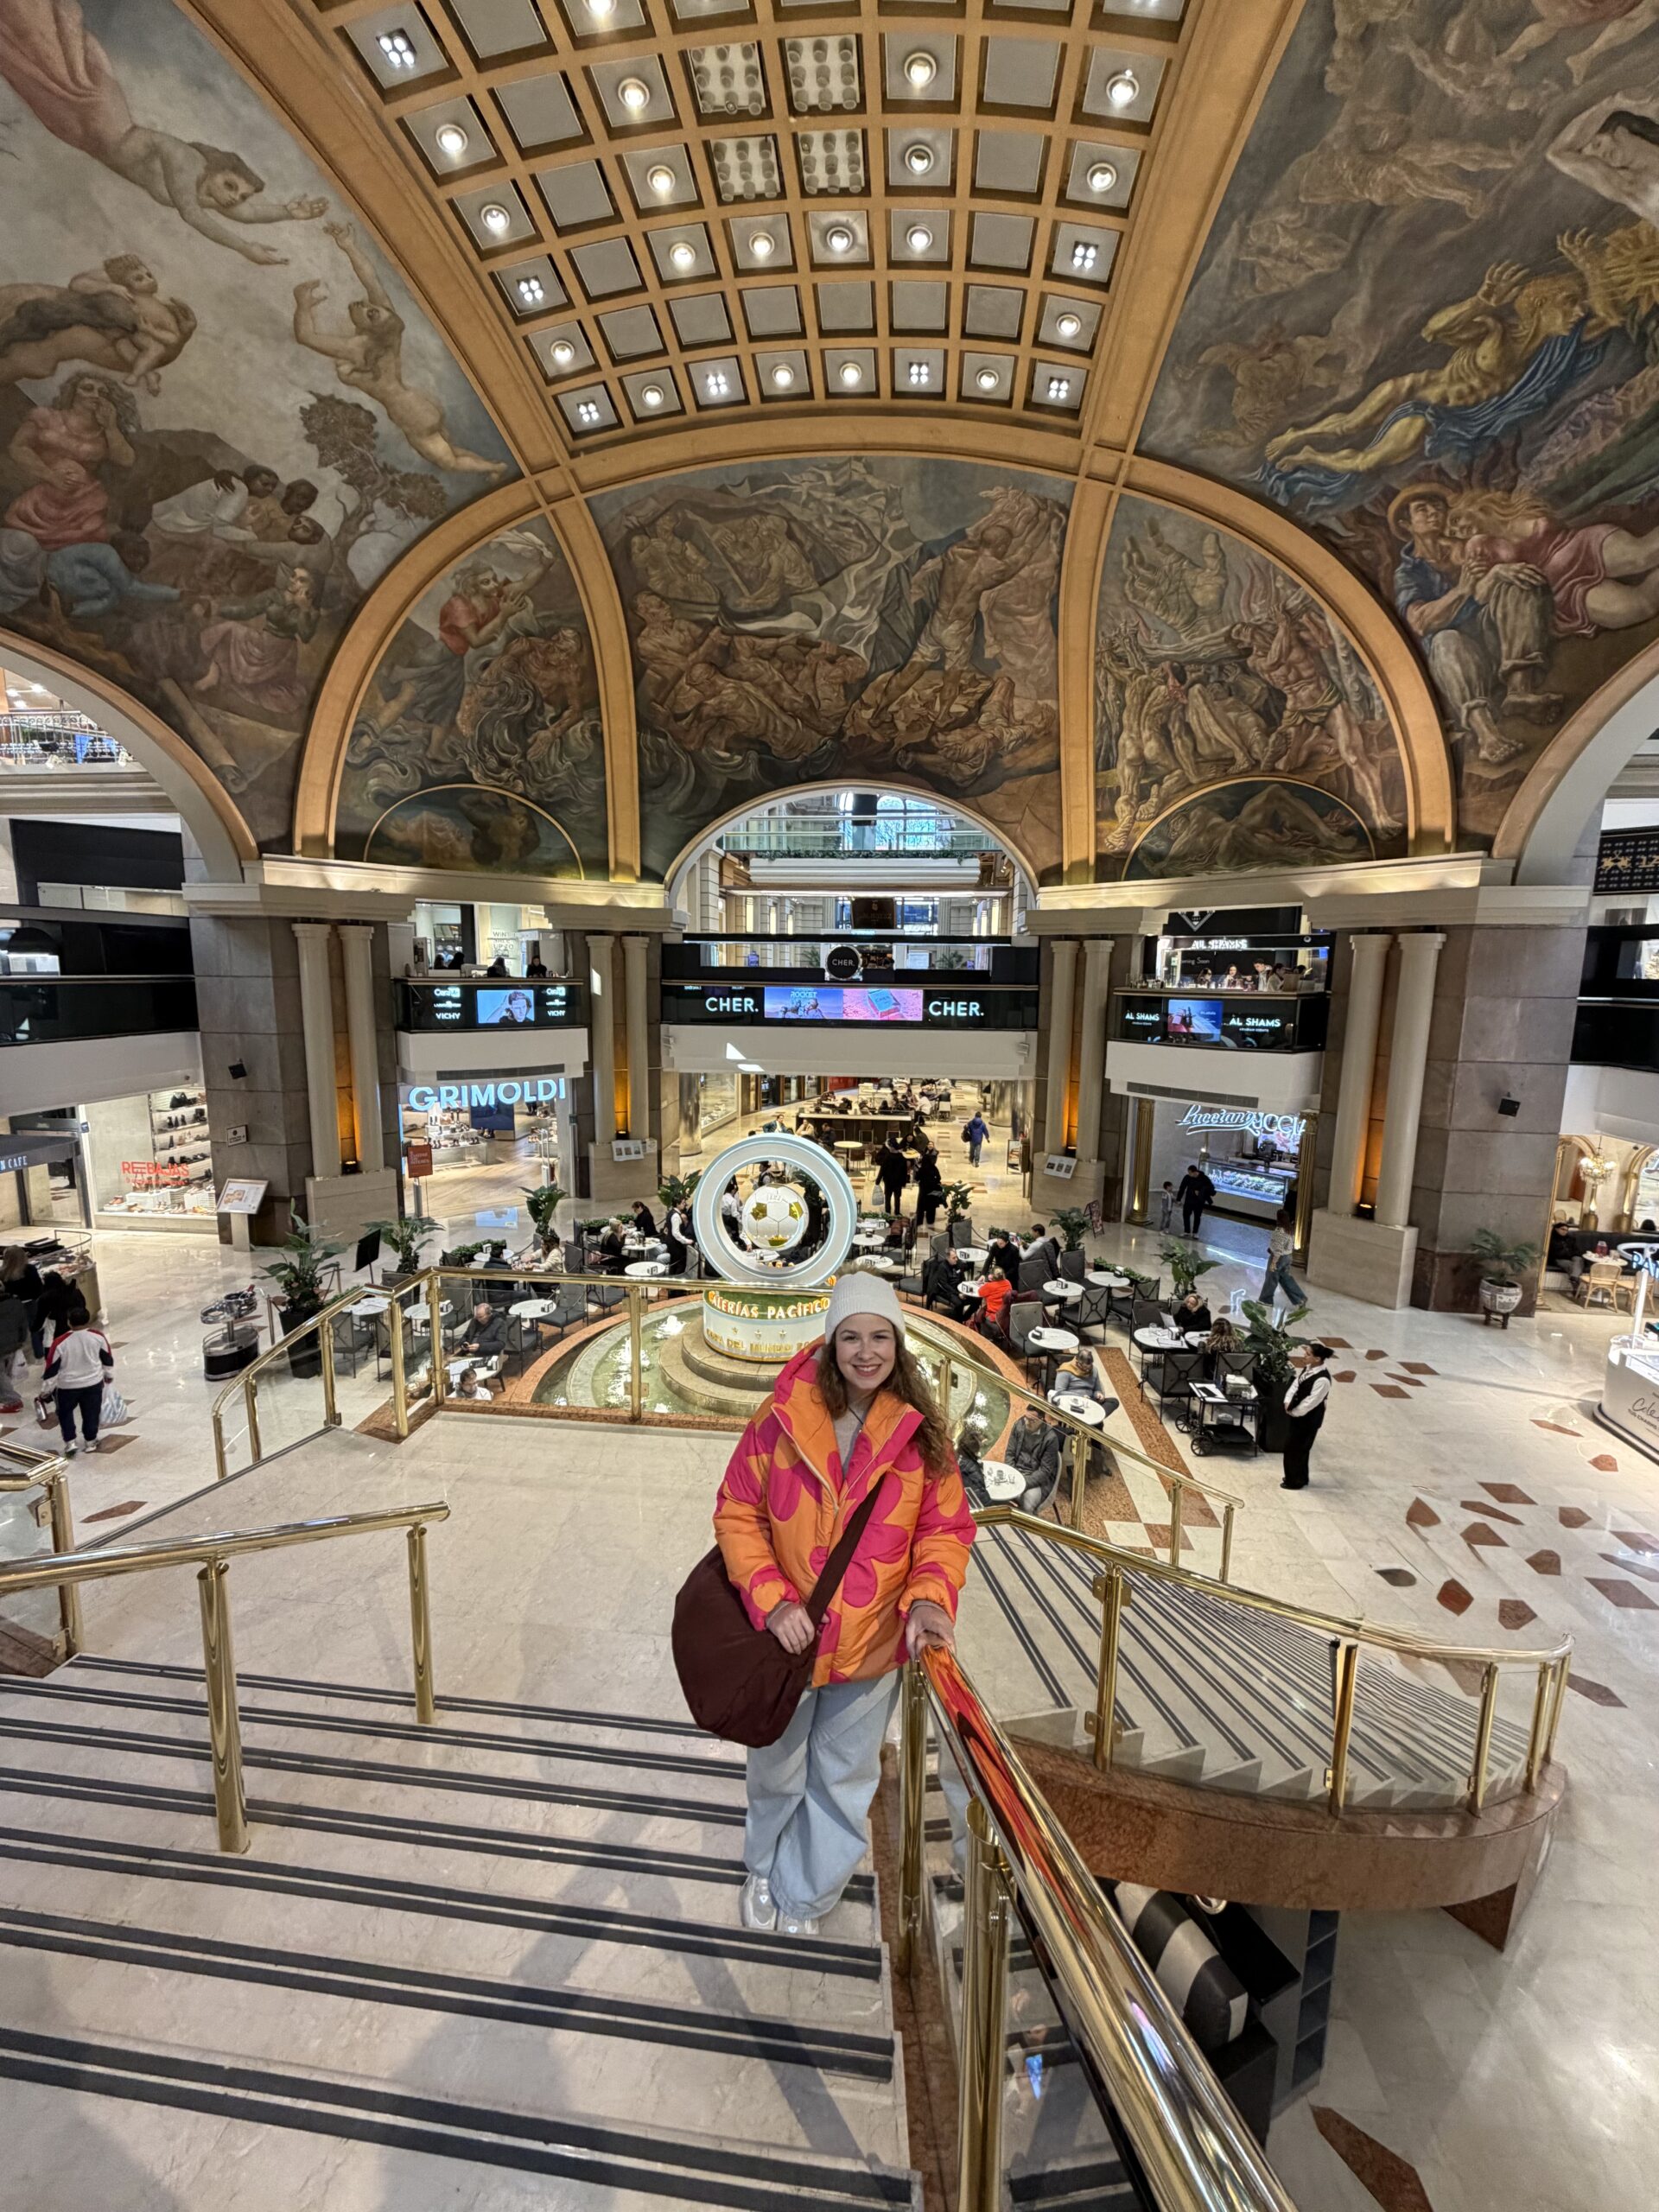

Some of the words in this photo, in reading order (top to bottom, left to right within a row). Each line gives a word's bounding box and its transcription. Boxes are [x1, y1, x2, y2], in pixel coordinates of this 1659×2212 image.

[705, 997, 759, 1013] CHER.
[928, 1001, 984, 1016] CHER.
[1135, 1012, 1160, 1021] SHAMS
[1245, 1017, 1281, 1027] SHAMS
[409, 1077, 566, 1111] GRIMOLDI
[8, 1155, 28, 1169] CAFE
[766, 1297, 831, 1319] PACÍFICO
[727, 1338, 746, 1351] DEL
